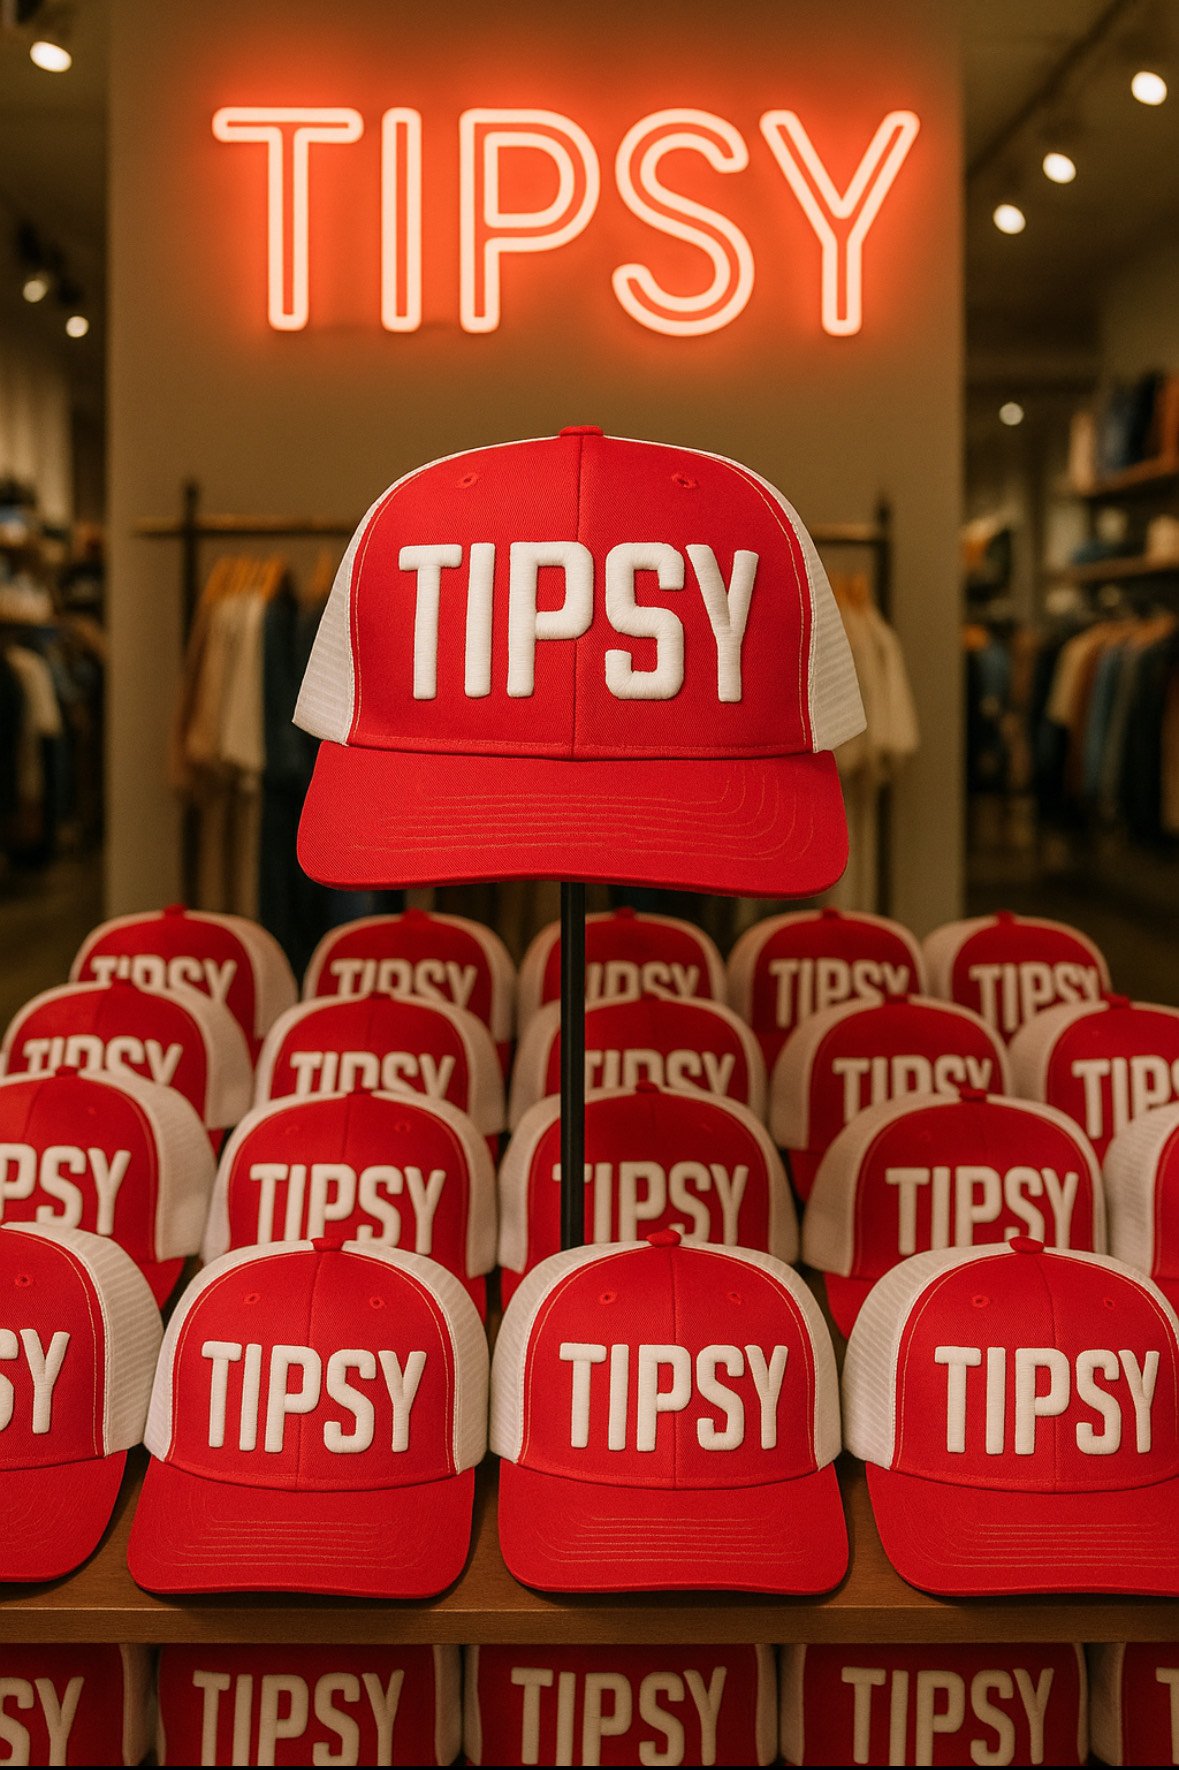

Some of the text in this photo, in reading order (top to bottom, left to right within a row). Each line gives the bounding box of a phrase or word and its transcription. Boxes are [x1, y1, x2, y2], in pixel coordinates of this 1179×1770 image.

[212, 107, 920, 336] TIPSY
[399, 541, 758, 703] TIPSY
[1072, 1054, 1179, 1139] TIP
[250, 1163, 447, 1255] TIPSY
[885, 1165, 1079, 1256] TIPSY
[202, 1340, 427, 1453] TIPSY
[559, 1342, 788, 1452] TIPSY
[934, 1345, 1160, 1455] TIPSY
[193, 1669, 404, 1766] TIPSY
[511, 1665, 726, 1766] TIPSY
[841, 1665, 1055, 1766] TIPSY
